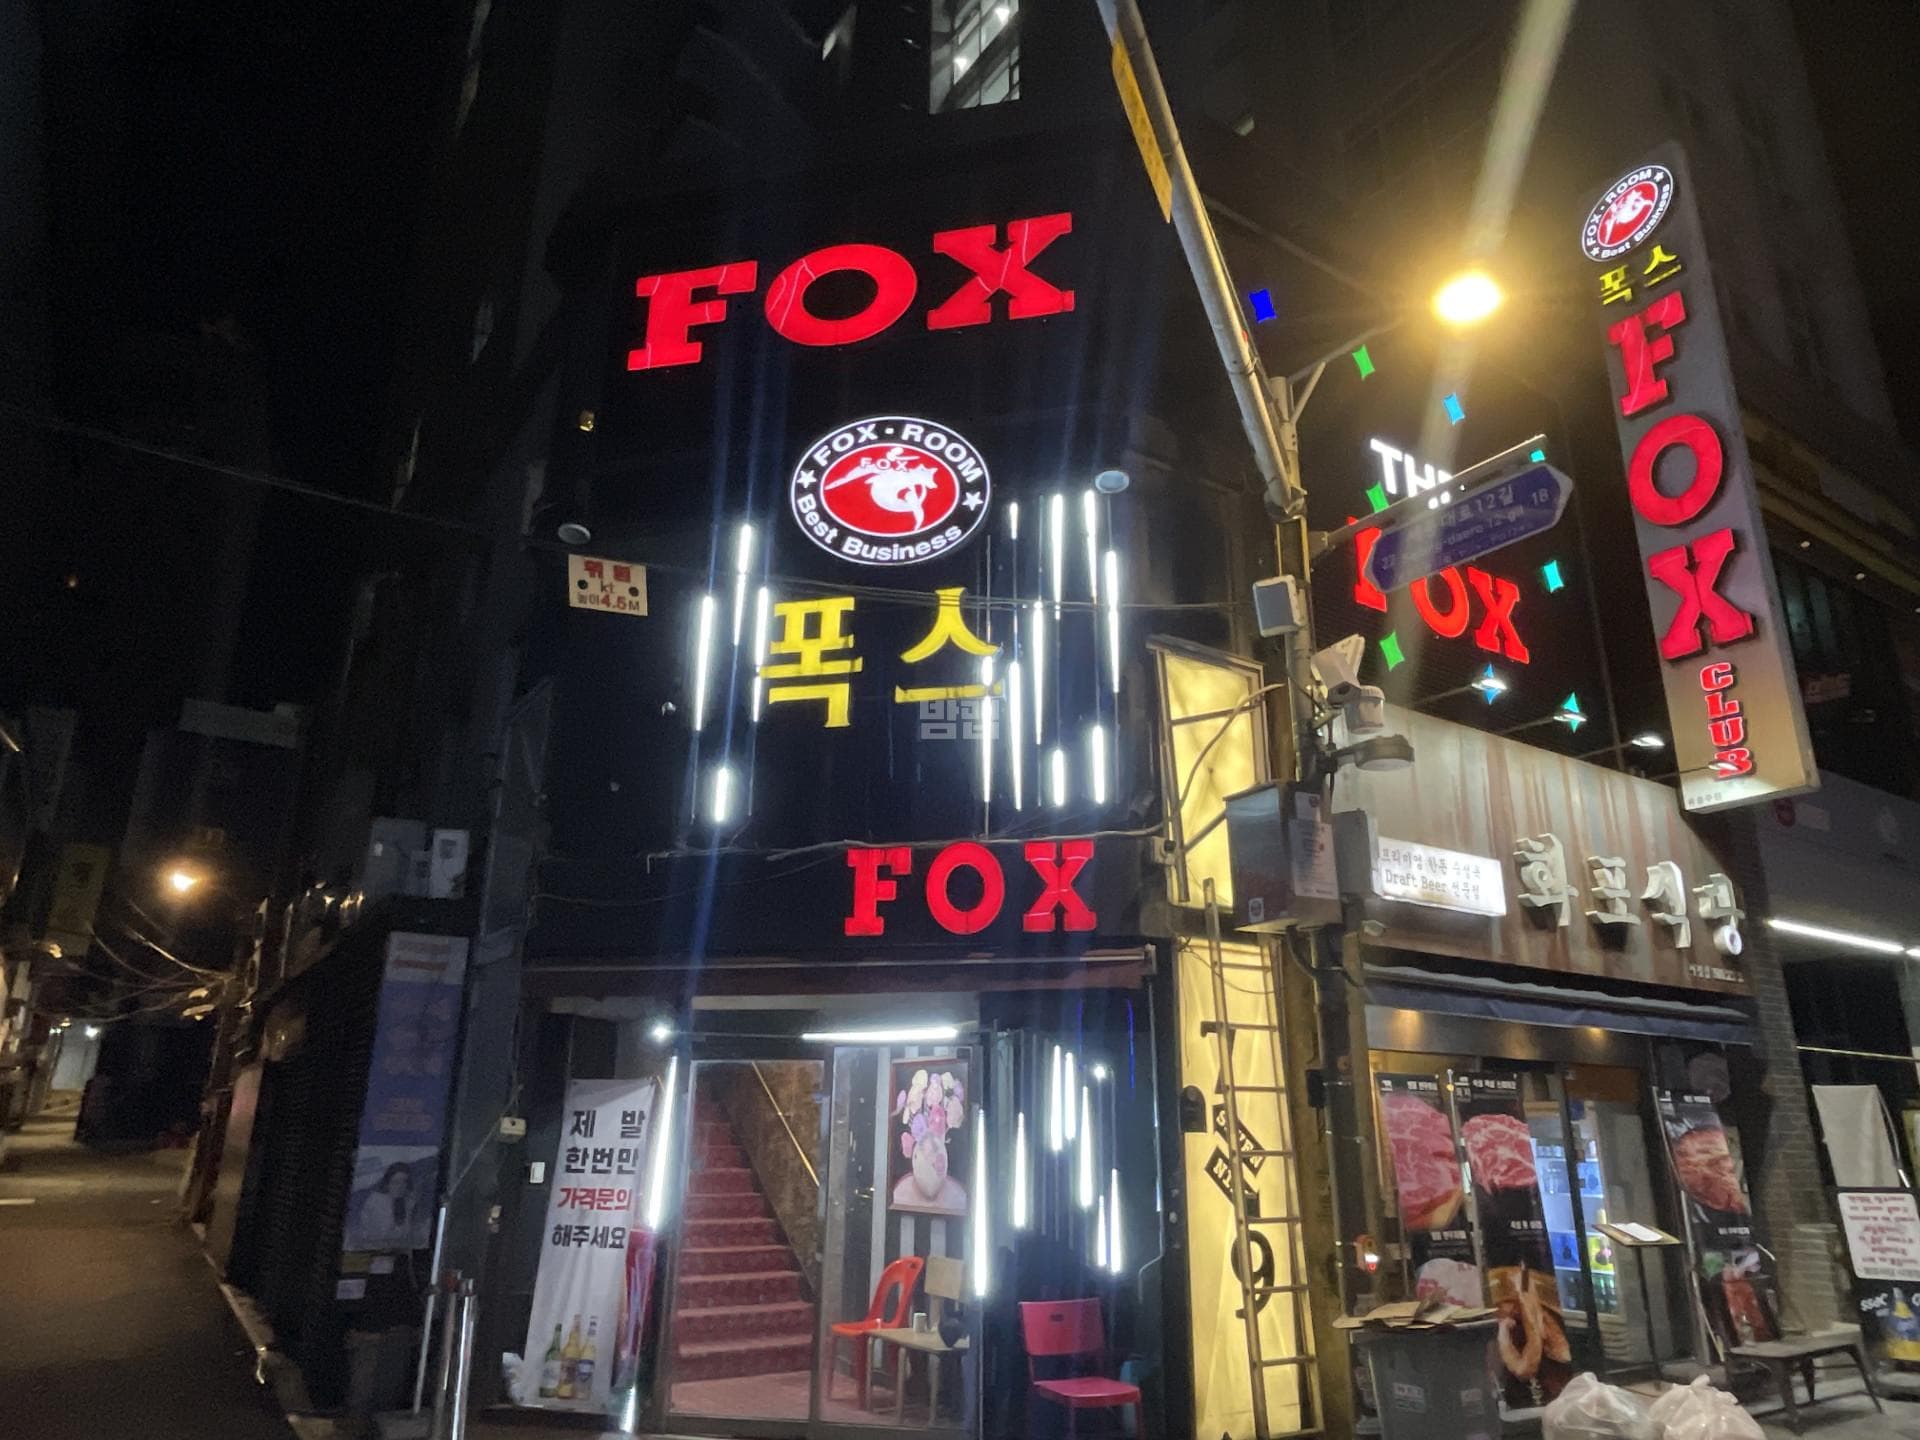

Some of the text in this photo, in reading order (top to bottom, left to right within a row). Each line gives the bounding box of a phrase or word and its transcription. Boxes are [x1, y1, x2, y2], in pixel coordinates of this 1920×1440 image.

[1605, 168, 1652, 204] ROOM
[1601, 183, 1671, 259] Best Business
[628, 212, 1075, 370] FOX
[1599, 245, 1682, 305] 폭스
[812, 423, 984, 484] FOX ROOM
[860, 457, 909, 472] FOX
[1370, 438, 1453, 498] TH
[1608, 290, 1756, 661] FOX
[797, 493, 962, 560] Best Business
[759, 587, 1005, 728] 폭스
[1700, 662, 1753, 781] CLUB
[844, 840, 1098, 937] FOX
[1384, 869, 1418, 888] Draft
[1420, 875, 1448, 893] Beer
[564, 1146, 639, 1175] 한번만
[558, 1187, 633, 1211] 가격문의
[551, 1224, 627, 1249] 해주세요
